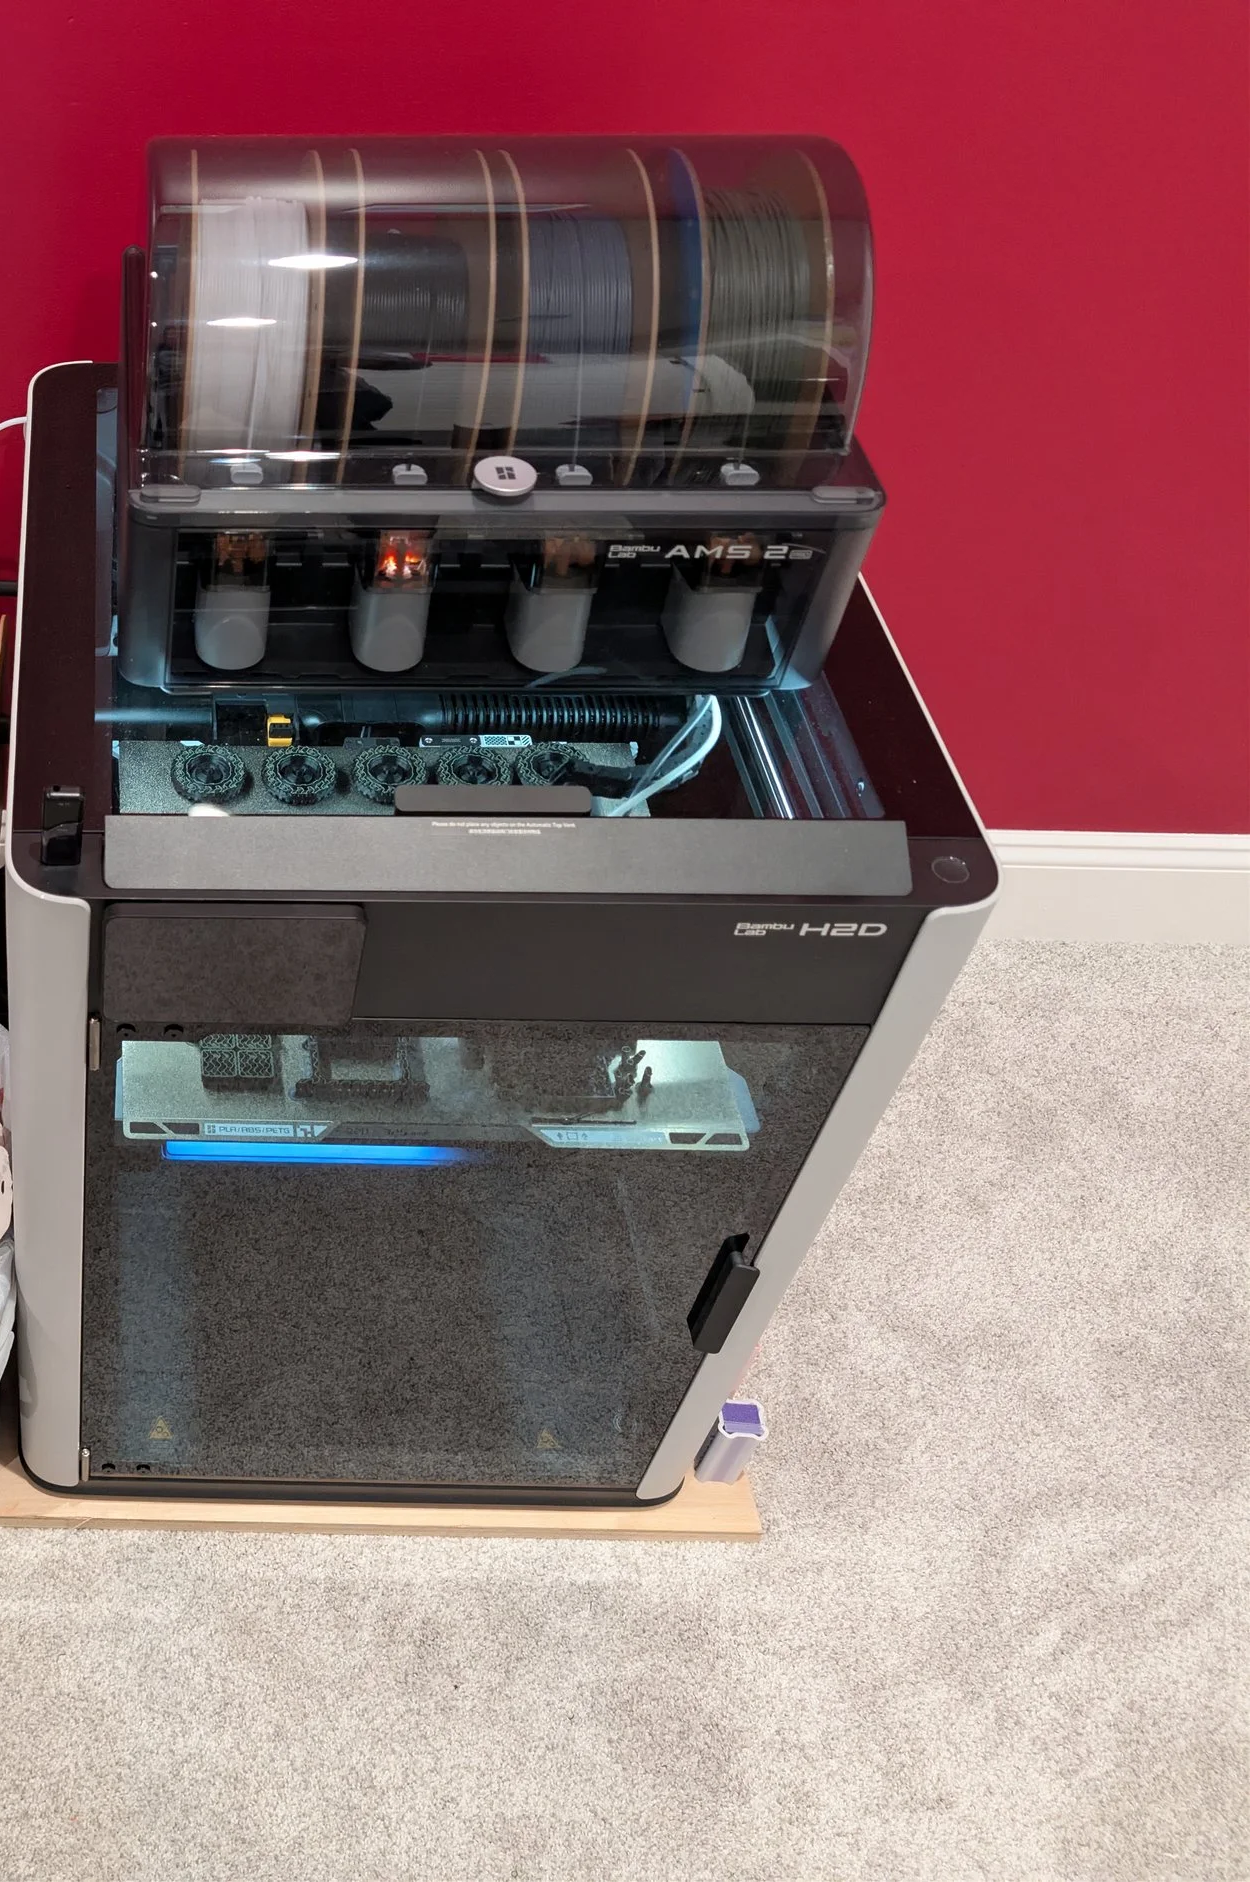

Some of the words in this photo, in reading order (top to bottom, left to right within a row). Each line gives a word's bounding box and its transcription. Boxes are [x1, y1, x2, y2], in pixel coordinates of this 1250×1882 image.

[609, 544, 660, 552] Bambu
[664, 545, 753, 559] AMS
[763, 545, 789, 559] 2
[608, 551, 637, 559] Lab
[736, 922, 795, 930] Bambu
[799, 923, 887, 936] H2D
[218, 1125, 291, 1135] PLA/ABS/PETG
